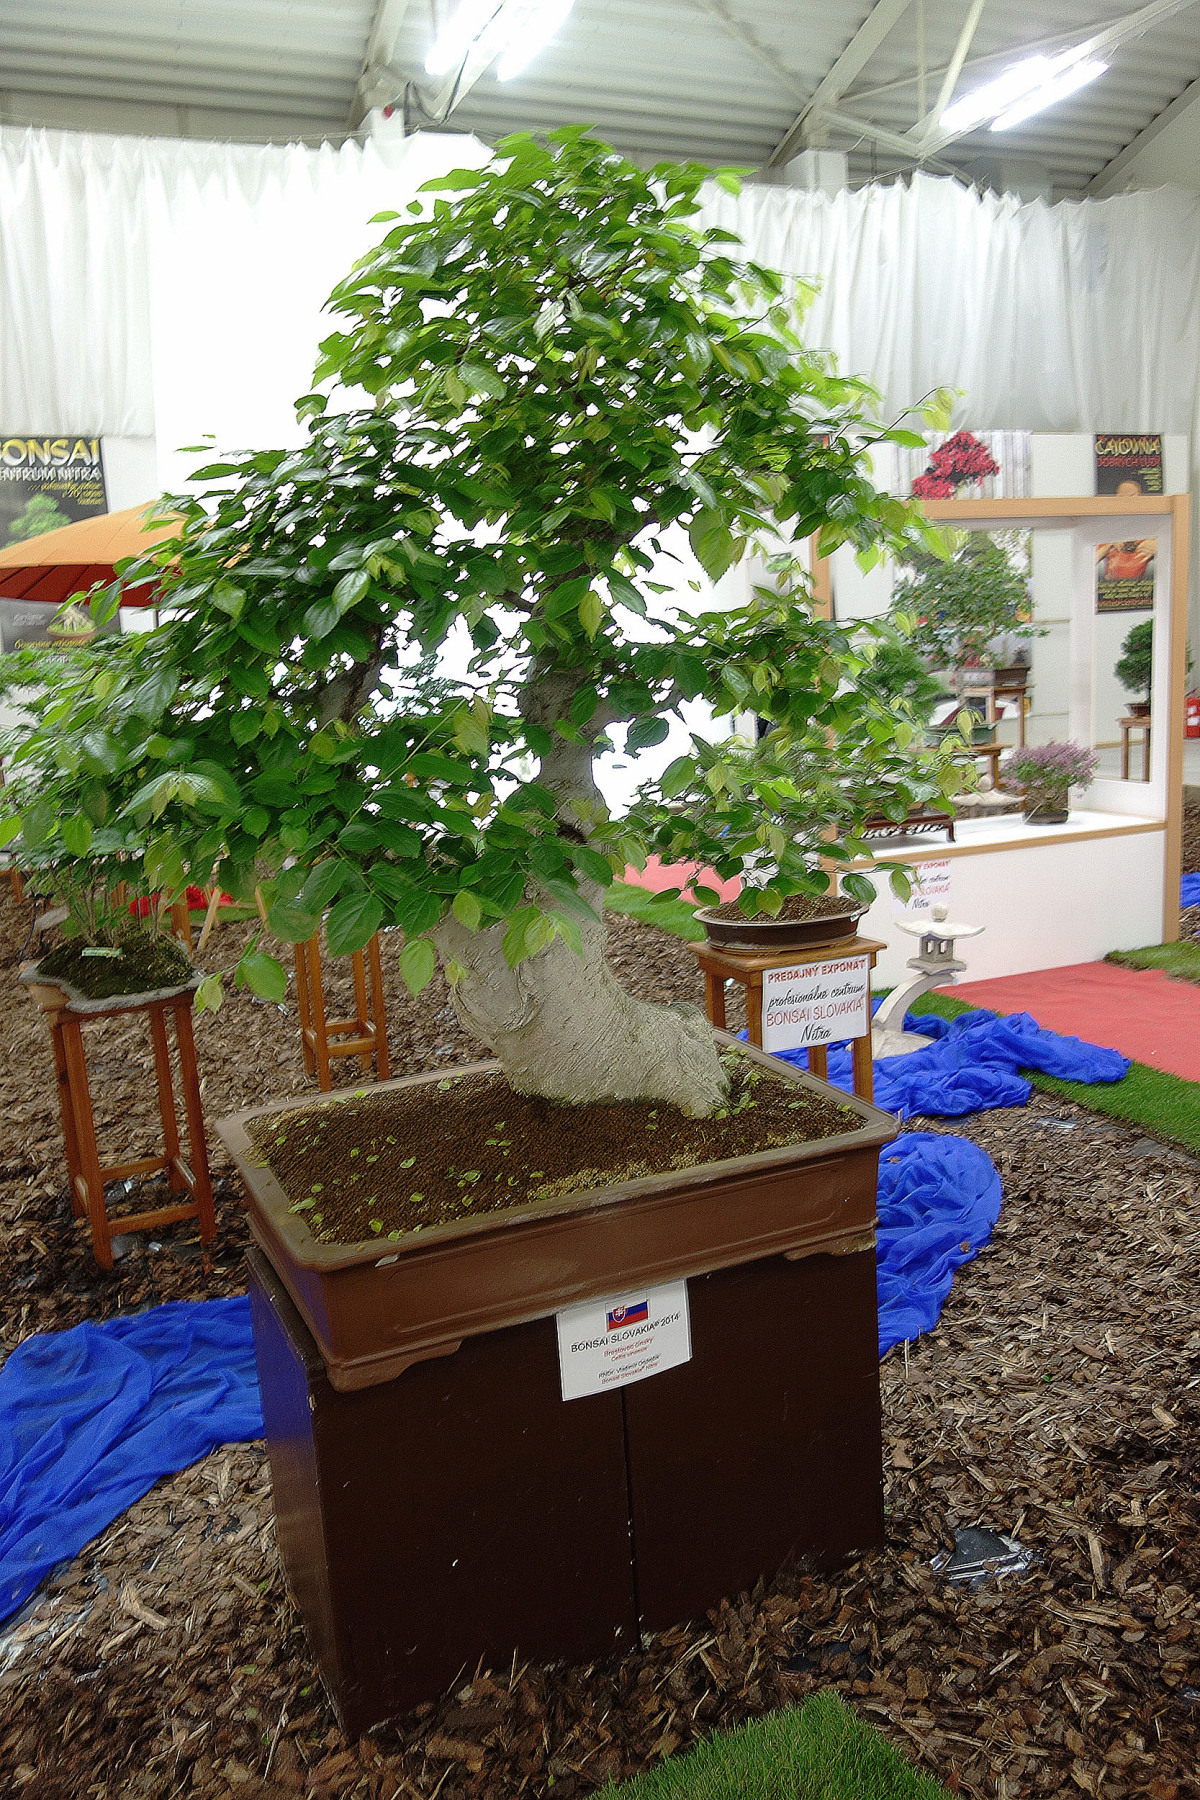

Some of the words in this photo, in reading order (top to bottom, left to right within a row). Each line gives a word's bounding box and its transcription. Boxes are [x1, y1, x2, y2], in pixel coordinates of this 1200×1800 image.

[0, 438, 100, 467] ONSAI
[0, 466, 57, 481] ENTRUM
[768, 964, 819, 984] PREDAJNÝ
[821, 958, 866, 976] EXPONÁT
[767, 983, 829, 1012] profesionálne
[831, 982, 865, 998] centrum
[766, 1007, 810, 1027] BONSAI
[801, 1023, 832, 1043] Nitra
[571, 1338, 608, 1353] BONSAI
[660, 1311, 680, 1327] 2014
